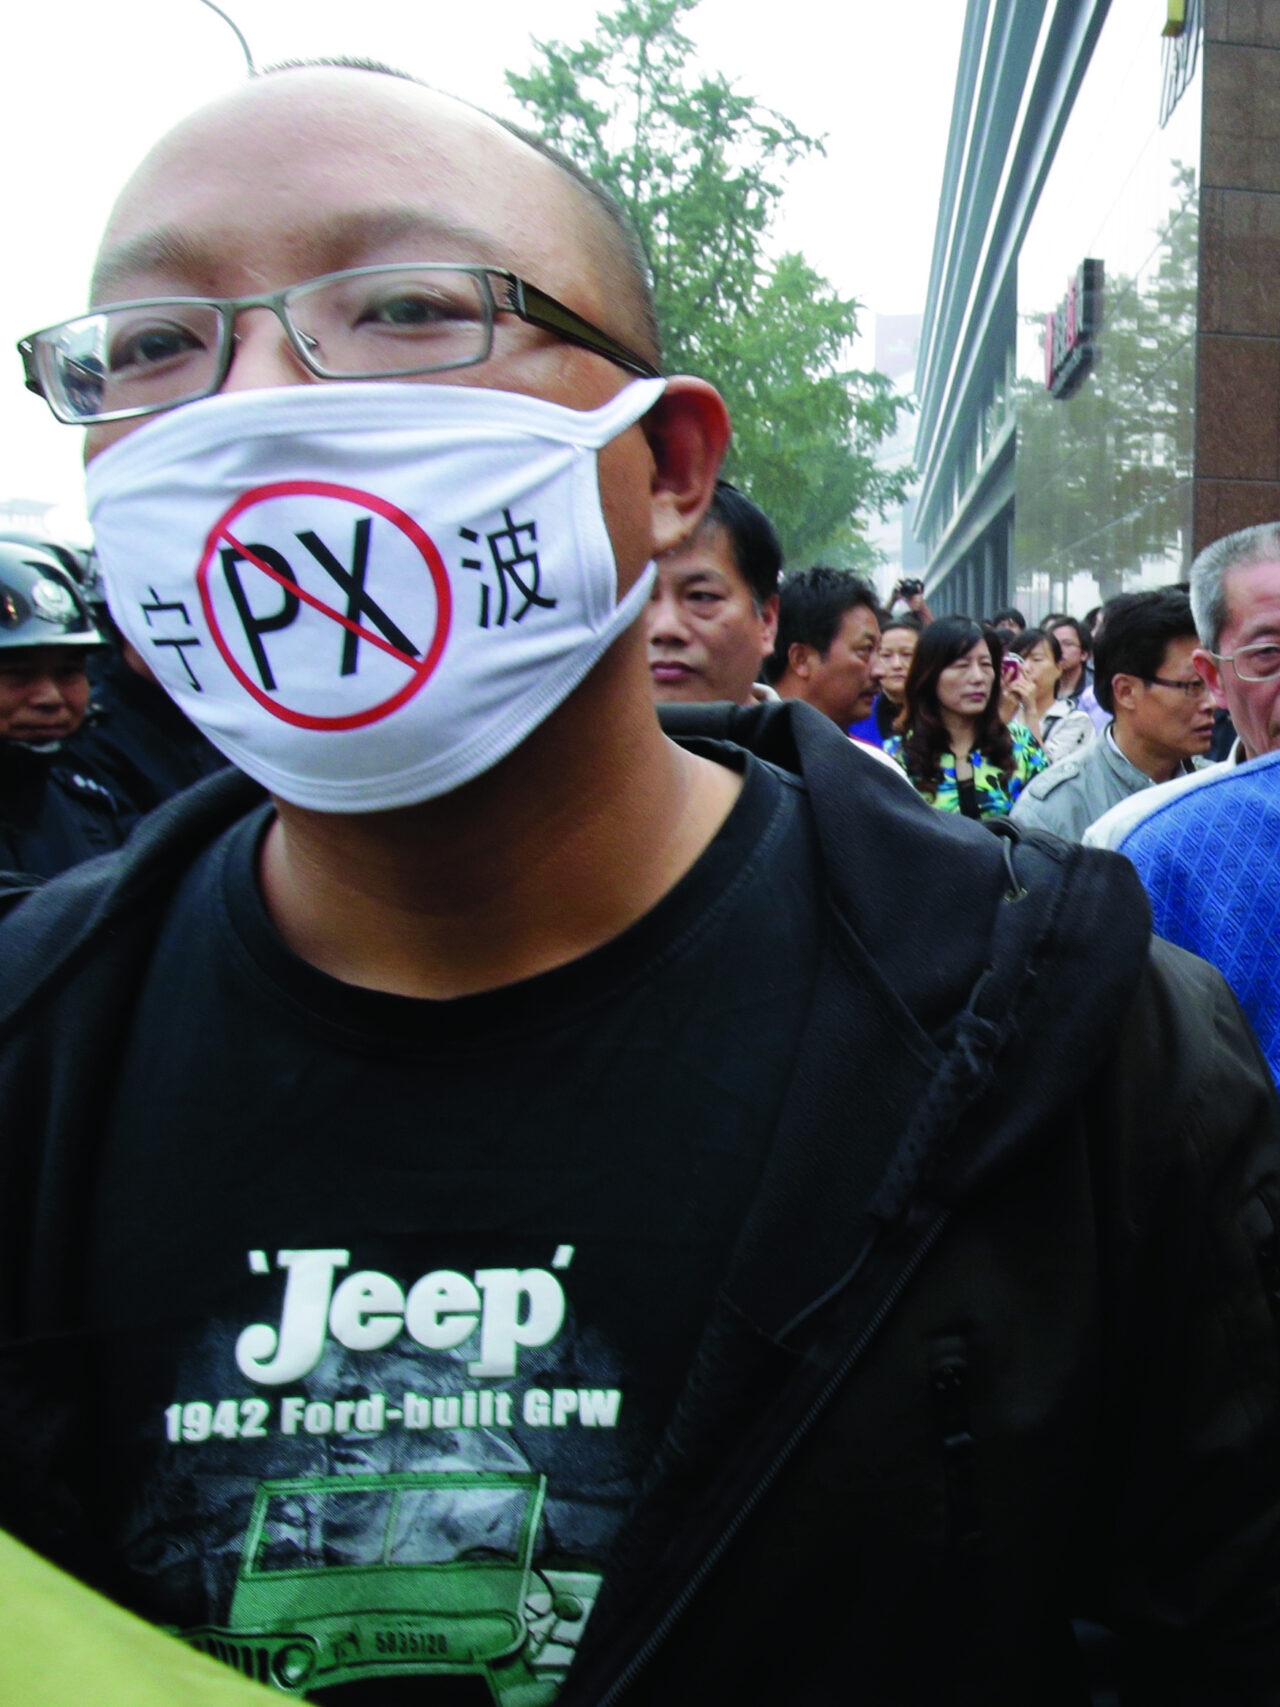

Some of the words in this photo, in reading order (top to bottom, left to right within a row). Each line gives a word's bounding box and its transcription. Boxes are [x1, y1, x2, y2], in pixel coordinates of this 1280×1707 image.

[217, 517, 422, 691] PX
[459, 508, 559, 629] 波
[140, 586, 203, 692] 宁
[164, 1401, 270, 1442] 1942
[279, 1393, 513, 1435] Ford-built
[522, 1389, 622, 1427] GPW
